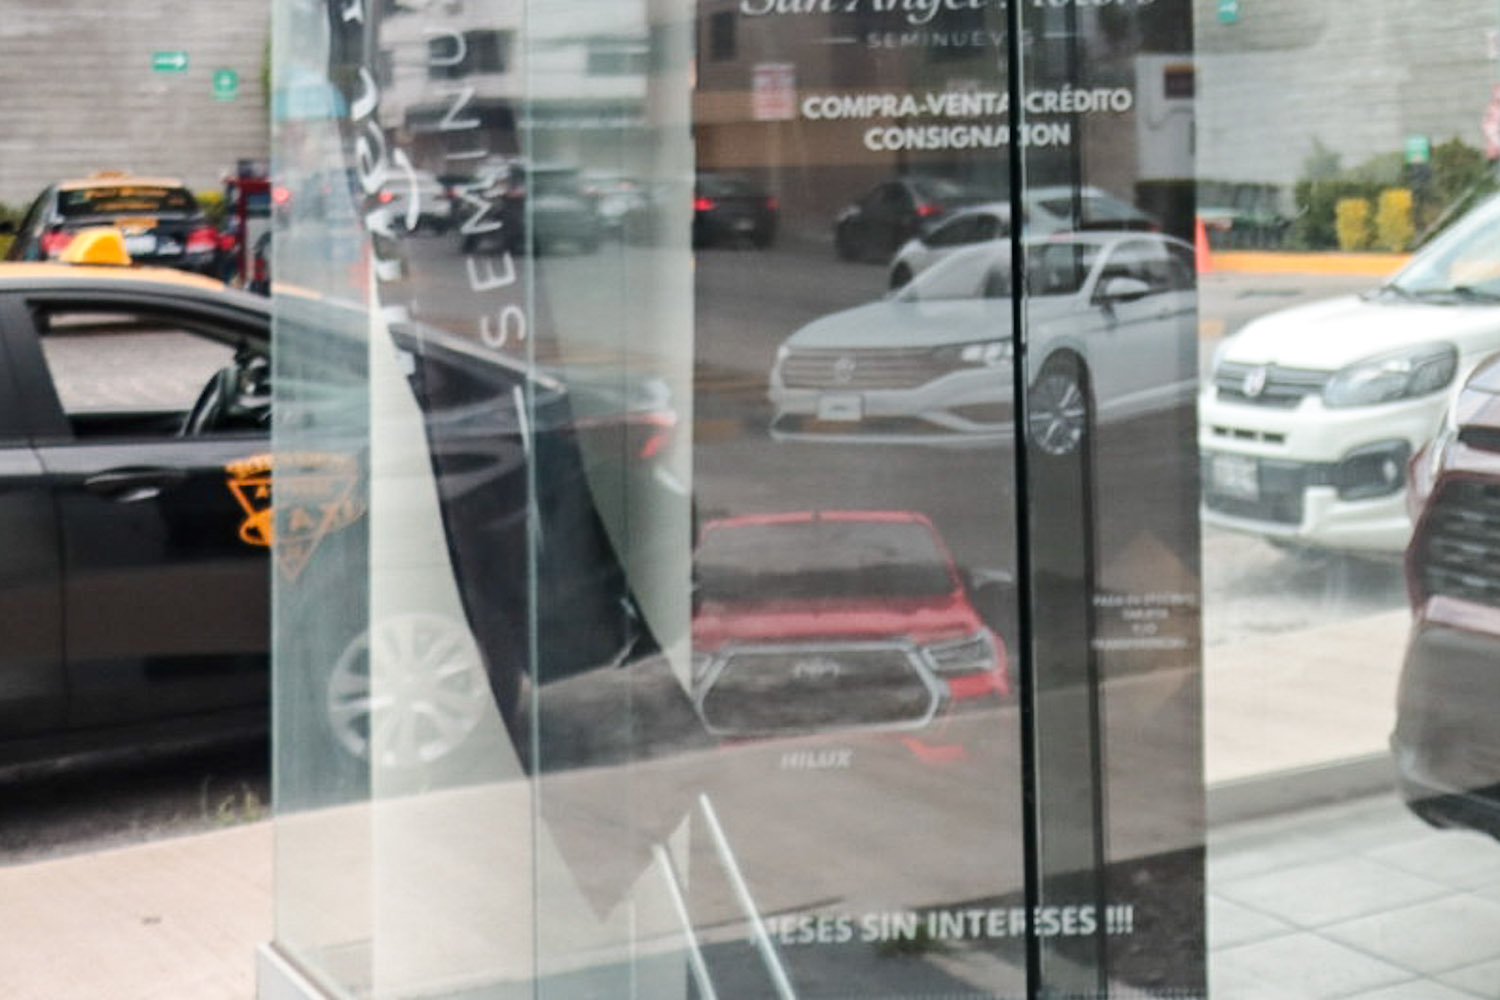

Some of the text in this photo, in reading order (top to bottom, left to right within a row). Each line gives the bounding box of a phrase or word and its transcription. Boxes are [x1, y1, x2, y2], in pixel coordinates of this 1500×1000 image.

[867, 32, 1034, 49] SEMINUEVS
[1025, 84, 1132, 114] CRÉDITO
[864, 124, 1070, 151] CONSIGNAION
[860, 910, 918, 942] SIN
